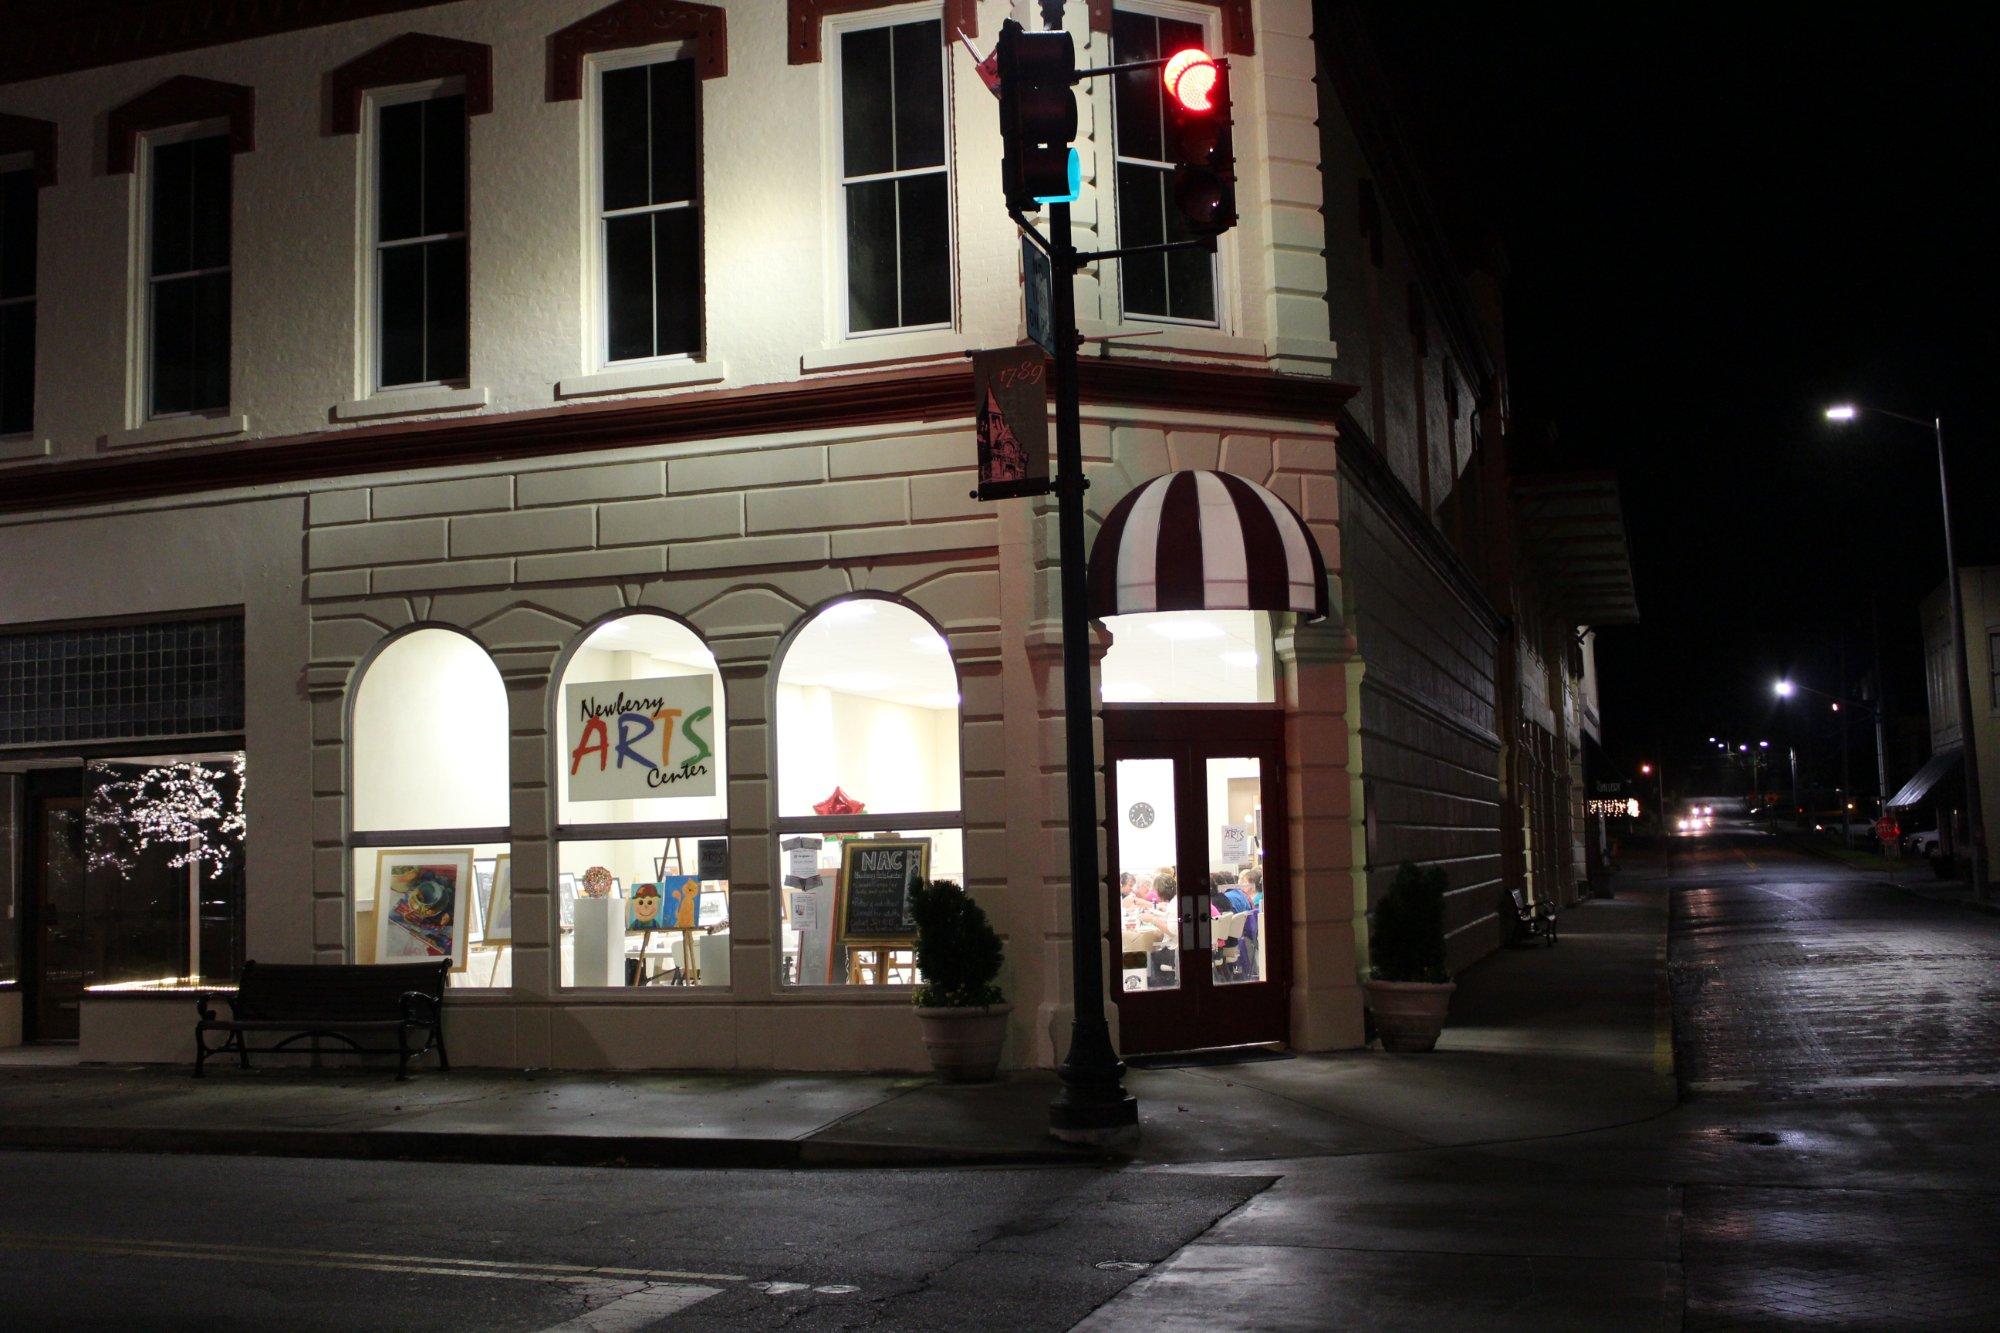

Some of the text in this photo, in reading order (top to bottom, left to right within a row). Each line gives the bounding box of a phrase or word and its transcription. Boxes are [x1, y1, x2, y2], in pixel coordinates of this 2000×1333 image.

[1000, 361, 1043, 388] 1789
[581, 692, 664, 722] Newberry
[571, 706, 712, 776] ARTS
[647, 764, 707, 788] Center
[861, 850, 903, 871] NAC
